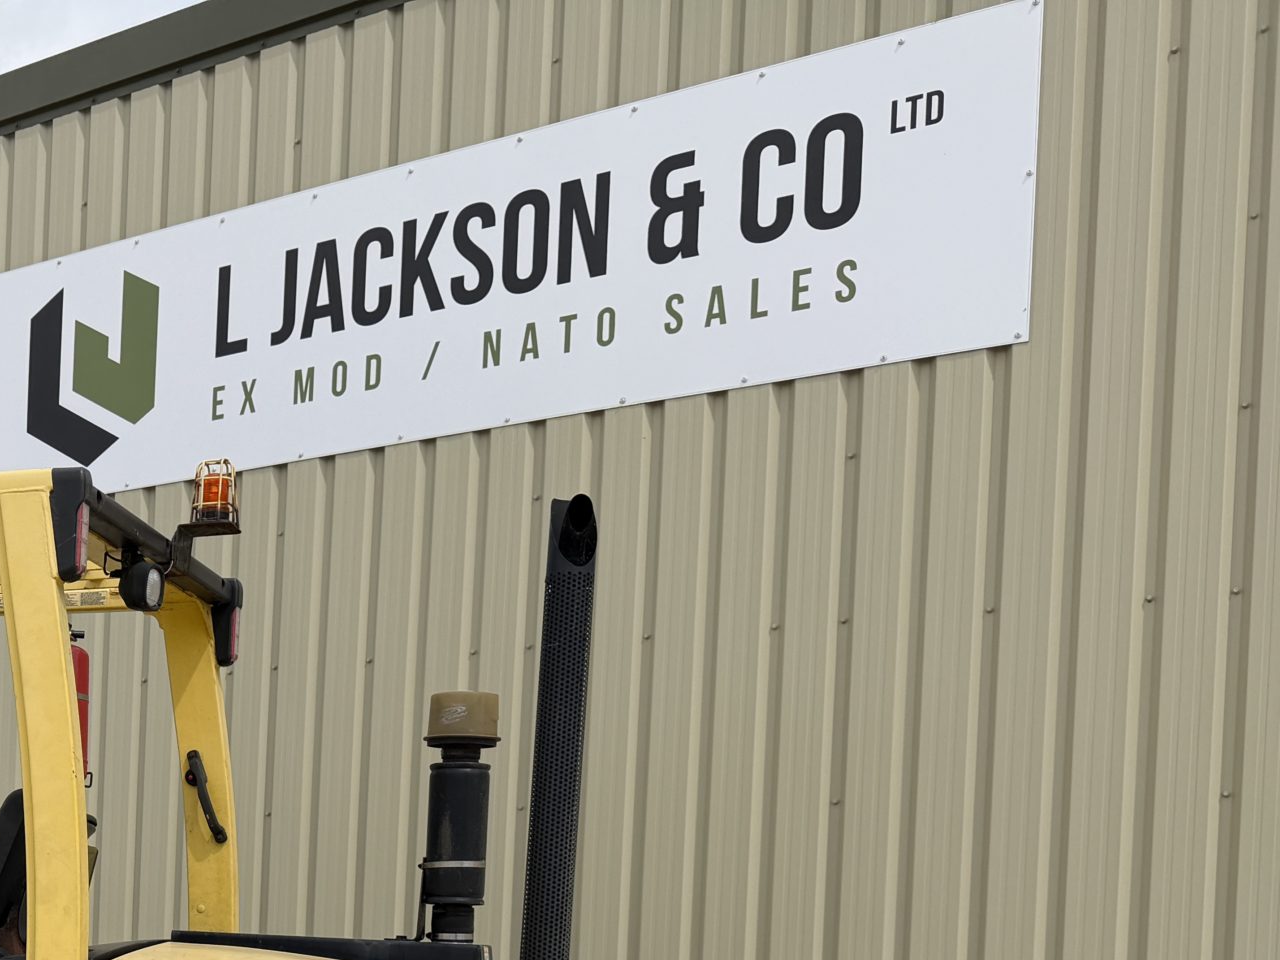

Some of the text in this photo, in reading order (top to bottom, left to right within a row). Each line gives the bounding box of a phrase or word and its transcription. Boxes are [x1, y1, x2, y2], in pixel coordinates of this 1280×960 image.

[215, 89, 945, 358] L JACKSON & CO LTD
[211, 259, 858, 421] EX MOD / NATO SALES
